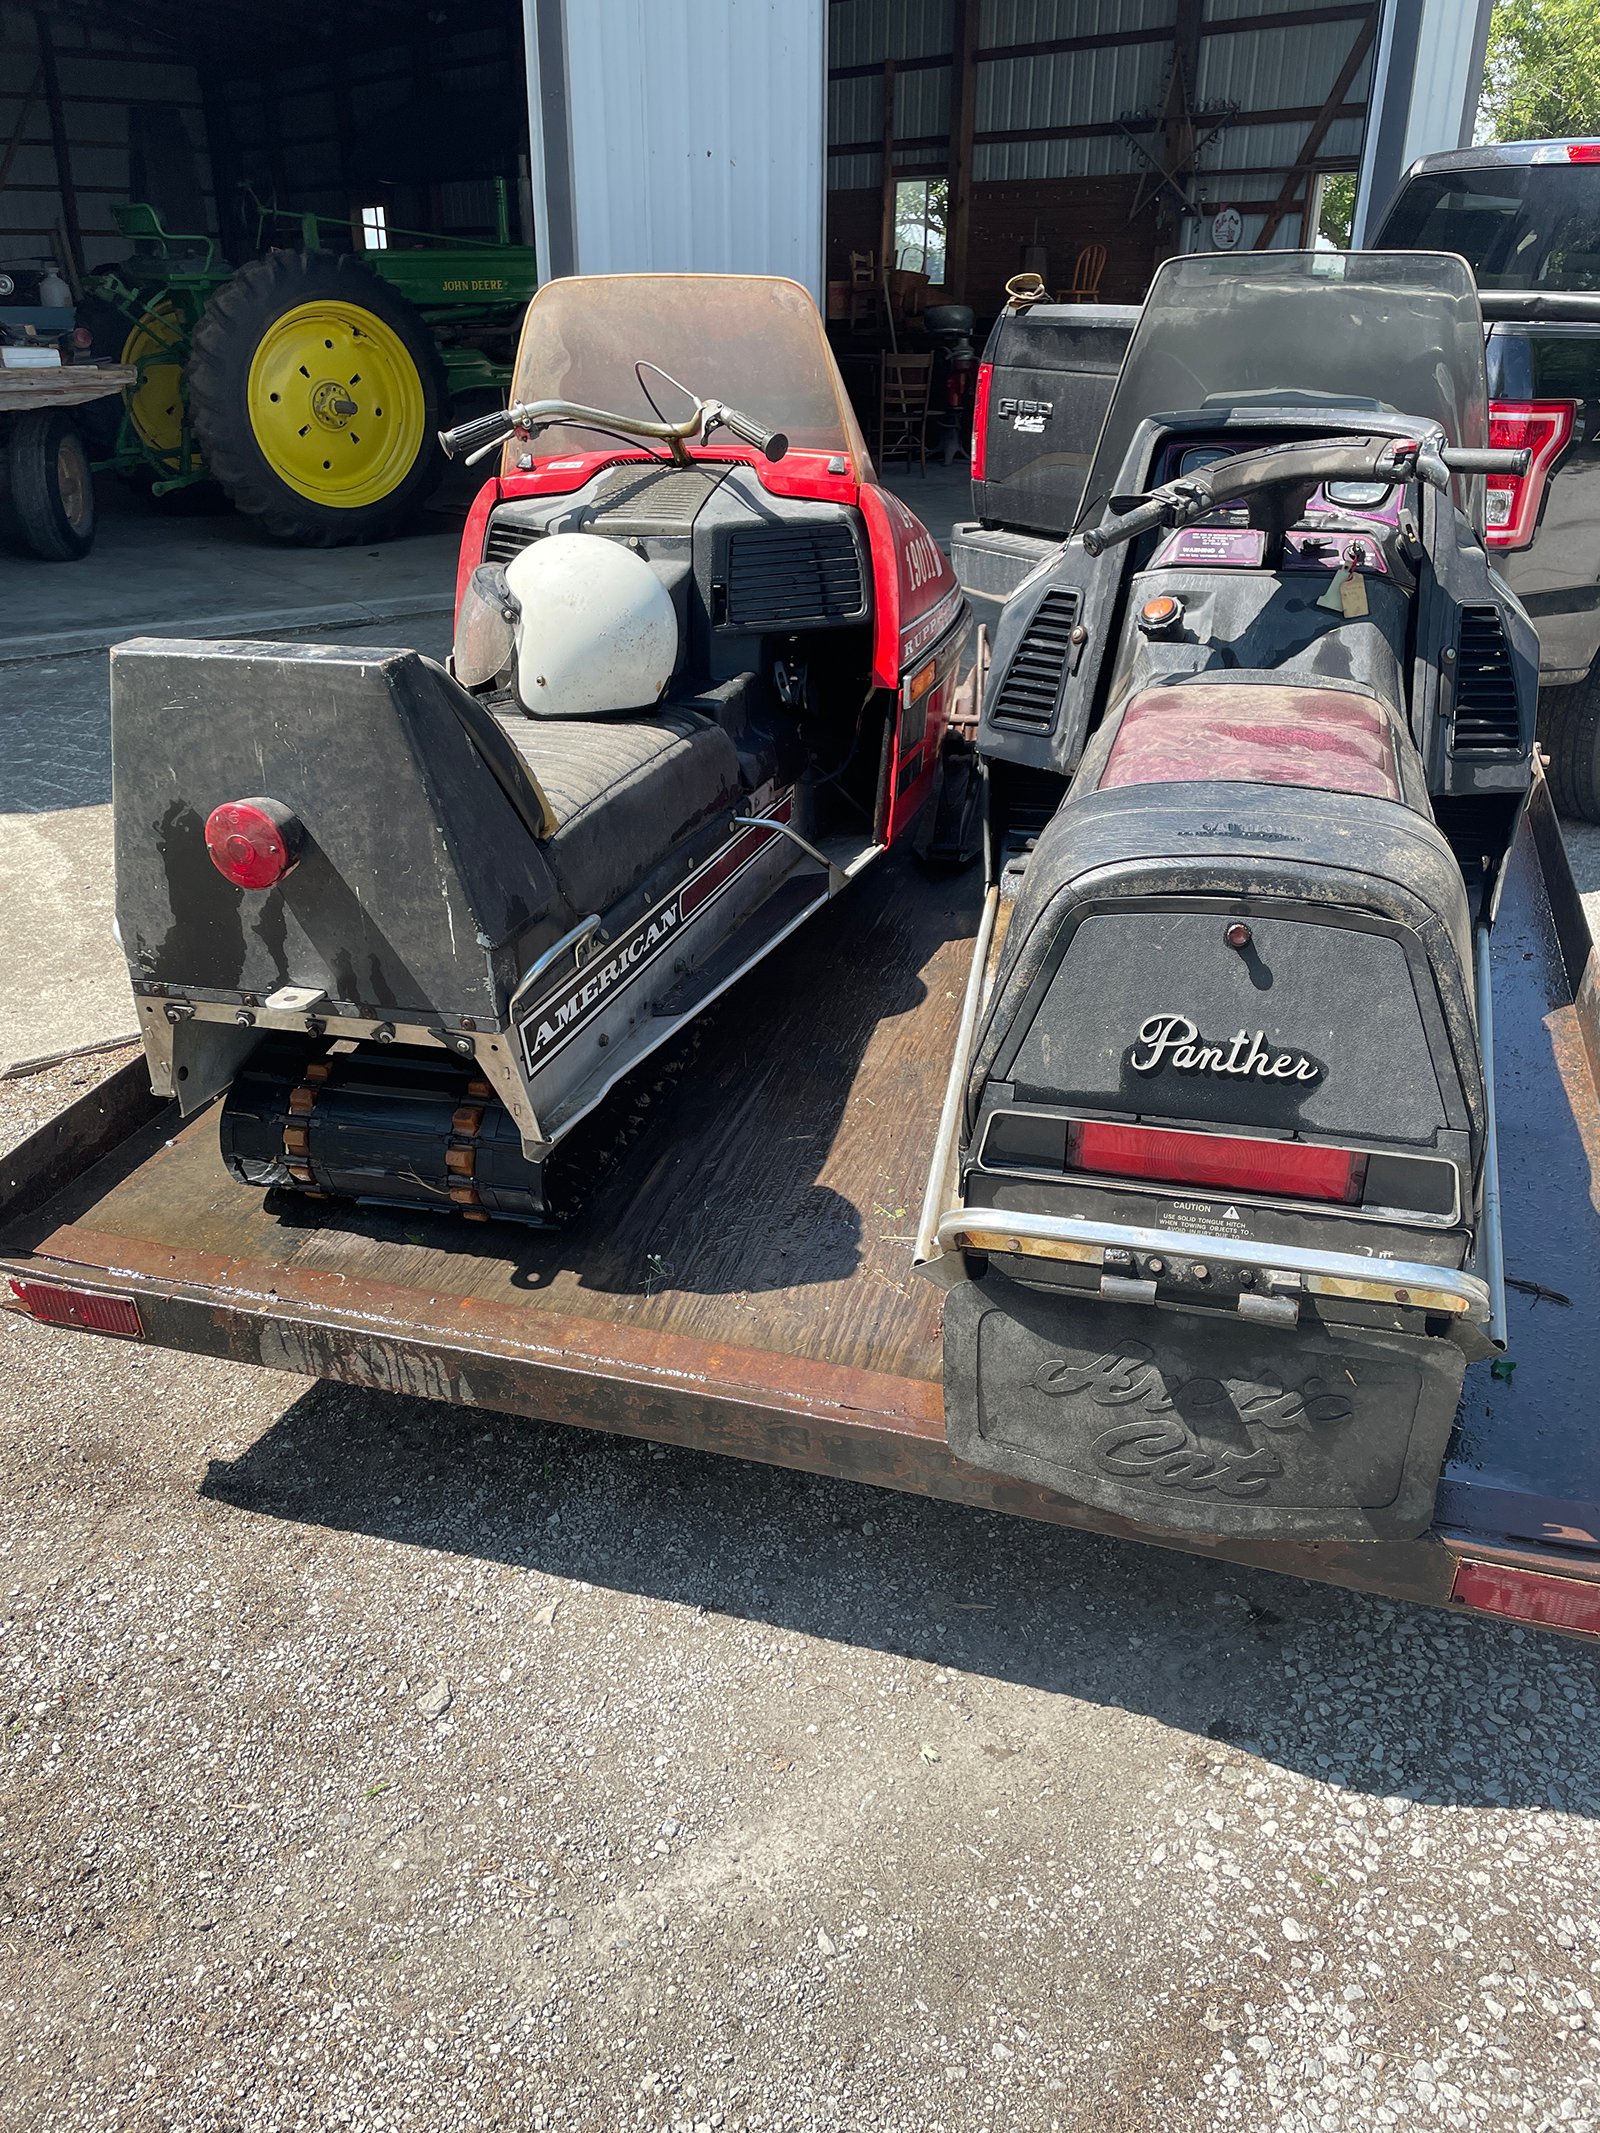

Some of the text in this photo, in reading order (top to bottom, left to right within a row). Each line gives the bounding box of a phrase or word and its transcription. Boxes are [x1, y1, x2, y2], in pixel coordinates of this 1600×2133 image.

[442, 279, 504, 292] JOHN DEERE
[998, 398, 1053, 417] F150
[531, 902, 678, 1057] AMERICAN
[1131, 1012, 1319, 1080] Panther
[1173, 1201, 1211, 1213] CAUTION
[1159, 1218, 1178, 1227] WHEN
[1181, 1221, 1207, 1231] TOWING
[1209, 1225, 1238, 1234] OBJECTS
[1167, 1226, 1186, 1234] AVOID
[1177, 1214, 1197, 1223] SOLID
[1198, 1217, 1225, 1226] TONGUE
[1226, 1221, 1246, 1229] HITCH
[1020, 1338, 1353, 1431] Arctic
[1090, 1419, 1284, 1496] Cat
